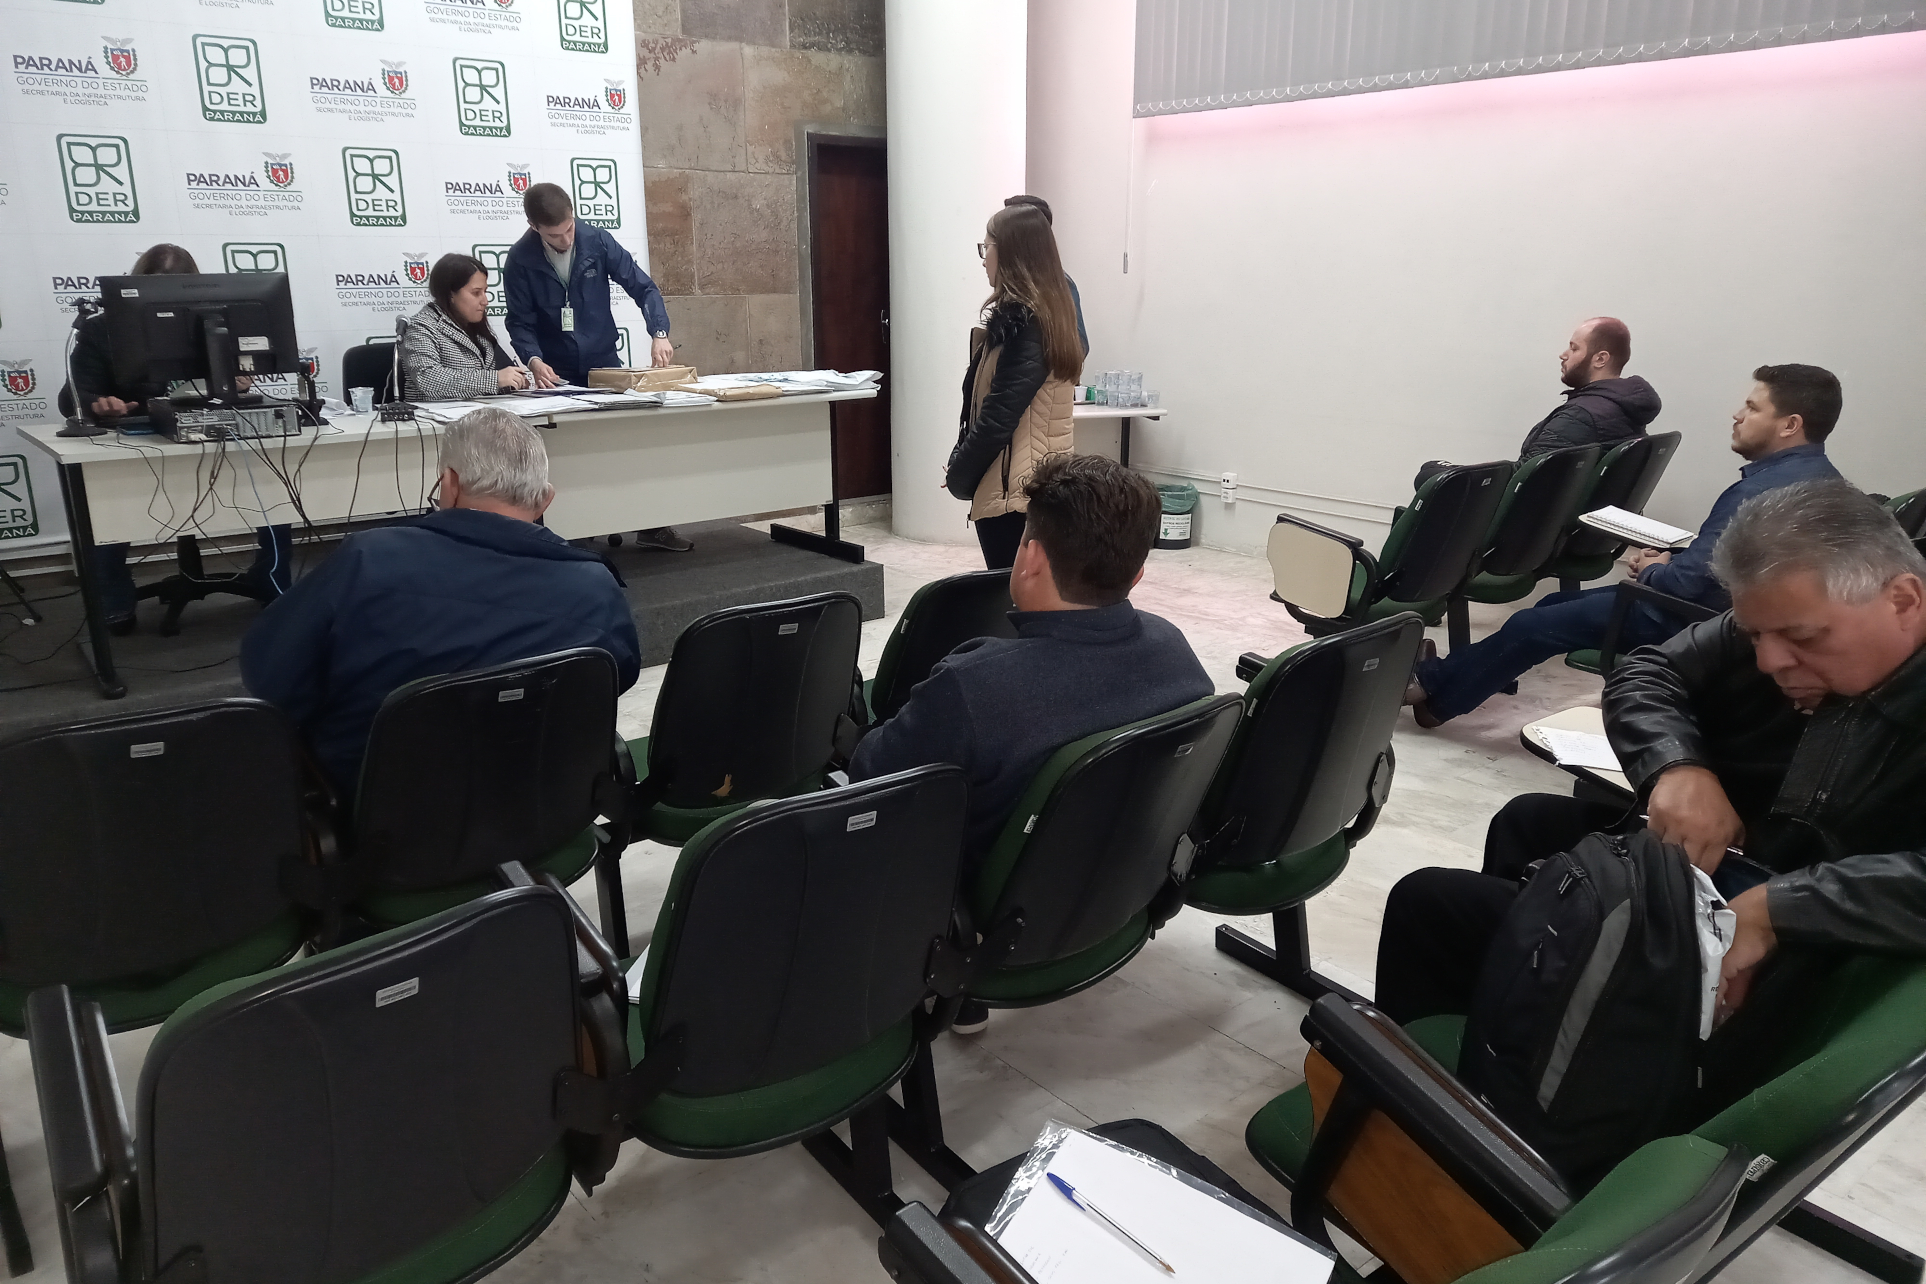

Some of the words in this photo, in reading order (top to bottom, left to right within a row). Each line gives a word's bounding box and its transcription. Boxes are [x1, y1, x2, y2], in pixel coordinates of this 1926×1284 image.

[331, 0, 376, 16] DER
[426, 6, 470, 18] GOVERNO
[473, 11, 486, 19] DO
[488, 13, 521, 23] ESTADO
[328, 17, 381, 30] PARANÁ
[565, 23, 601, 39] DER
[563, 41, 606, 52] PARANÁ
[13, 54, 99, 74] PARANÁ
[16, 76, 78, 88] GOVERNO
[81, 80, 100, 90] DO
[103, 82, 148, 93] ESTADO
[310, 77, 377, 94] PARANÁ
[208, 91, 257, 108] DER
[312, 96, 360, 106] GOVERNO
[363, 99, 377, 107] DO
[380, 100, 416, 110] ESTADO
[547, 95, 601, 110] PARANÁ
[206, 112, 264, 122] PARANÁ
[464, 108, 503, 123] DER
[548, 112, 587, 121] GOVERNO
[589, 114, 601, 122] DO
[603, 115, 632, 124] ESTADO
[462, 126, 509, 136] PARANÁ
[186, 171, 260, 188] PARANÁ
[445, 180, 504, 195] PARANÁ
[74, 191, 129, 207] DER
[189, 192, 242, 200] GOVERNO
[245, 193, 260, 201] DO
[263, 194, 303, 202] ESTADO
[447, 199, 488, 207] GOVERNO
[355, 198, 398, 212] DER
[580, 204, 615, 216] DER
[73, 212, 137, 221] PARANÁ
[353, 216, 404, 225] PARANÁ
[335, 270, 400, 286] PARANÁ
[338, 291, 383, 299] GOVERNO
[403, 290, 430, 298] ESTAD
[486, 291, 506, 302] DE
[0, 402, 47, 412] ESTADO
[0, 509, 28, 523] ER
